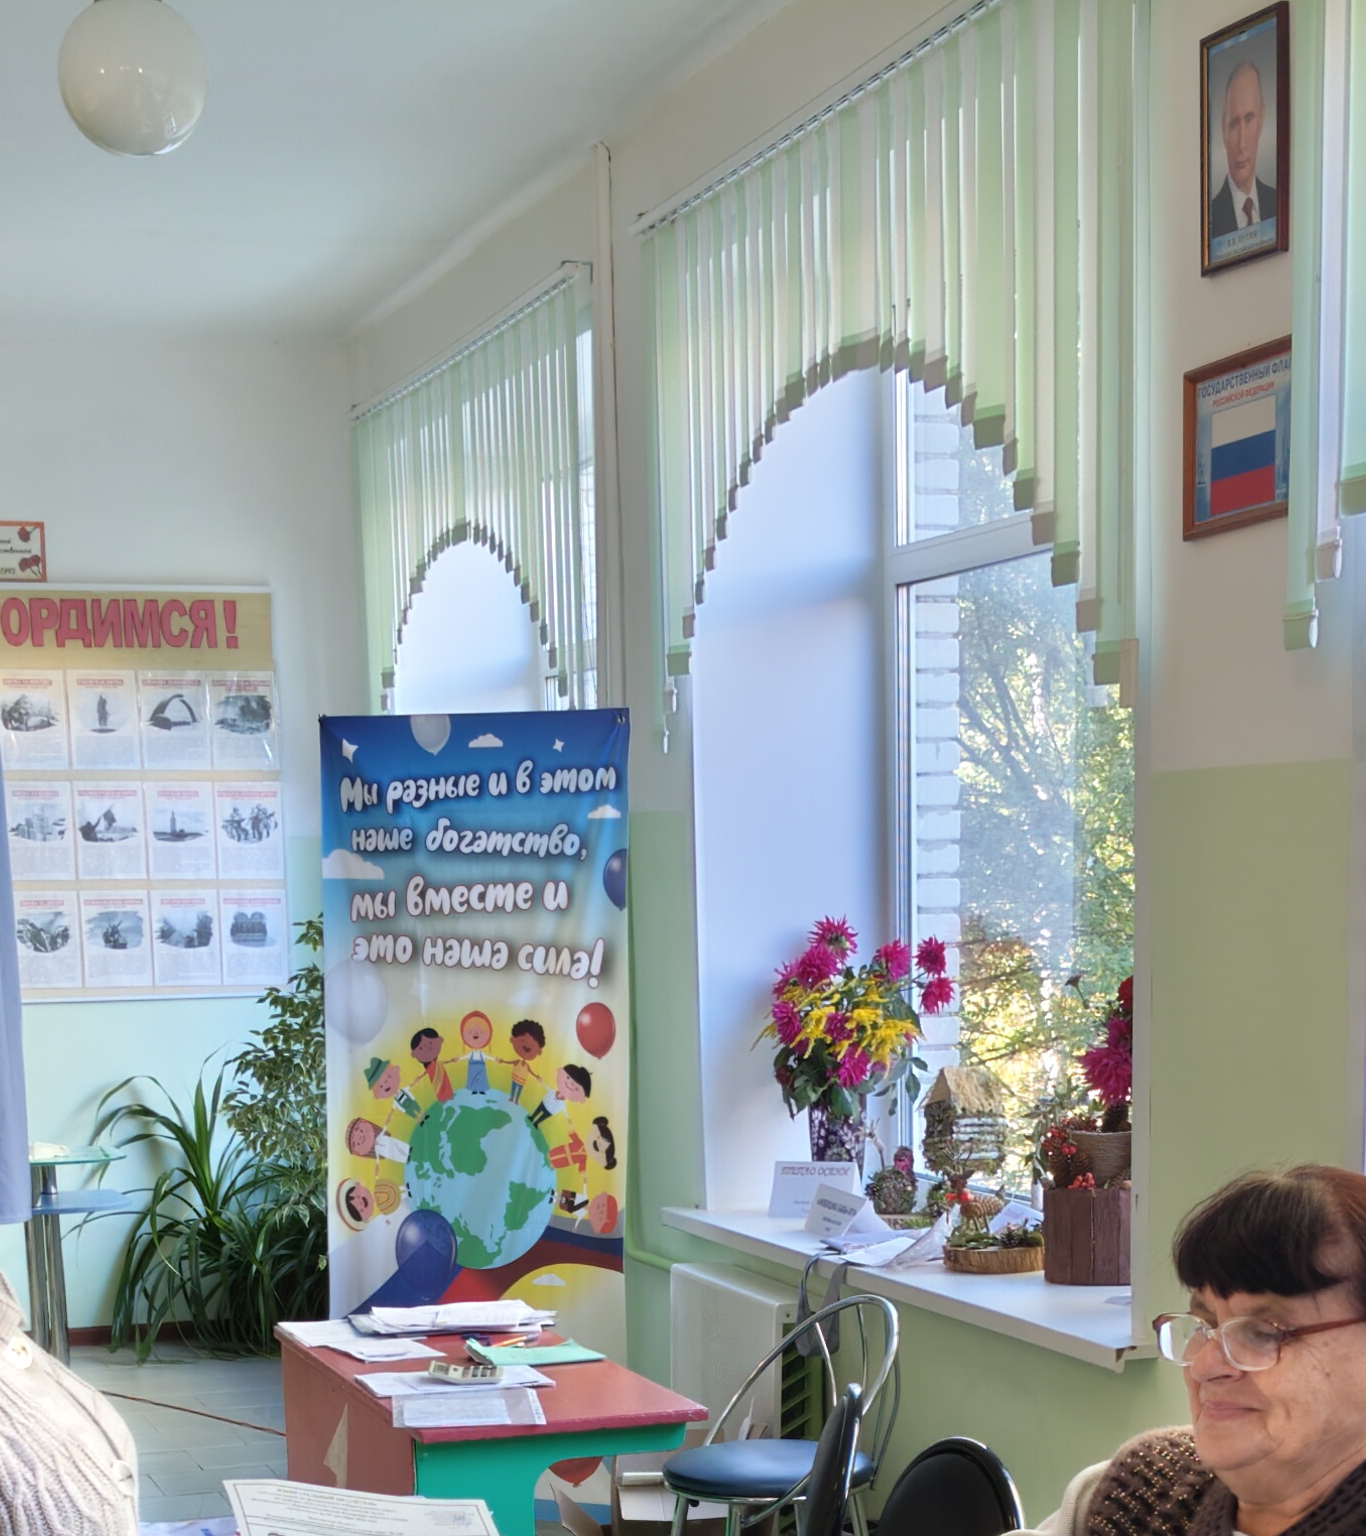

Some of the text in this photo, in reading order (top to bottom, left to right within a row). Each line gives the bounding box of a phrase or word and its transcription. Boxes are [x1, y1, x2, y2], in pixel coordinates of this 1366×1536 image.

[1197, 363, 1271, 398] ГОСУДАРСТВЕННЫЙ
[339, 759, 617, 815] Мы разные и в этом
[351, 817, 588, 862] наше богатство,
[350, 875, 569, 922] мы вместе и
[350, 933, 606, 989] это наша сила!
